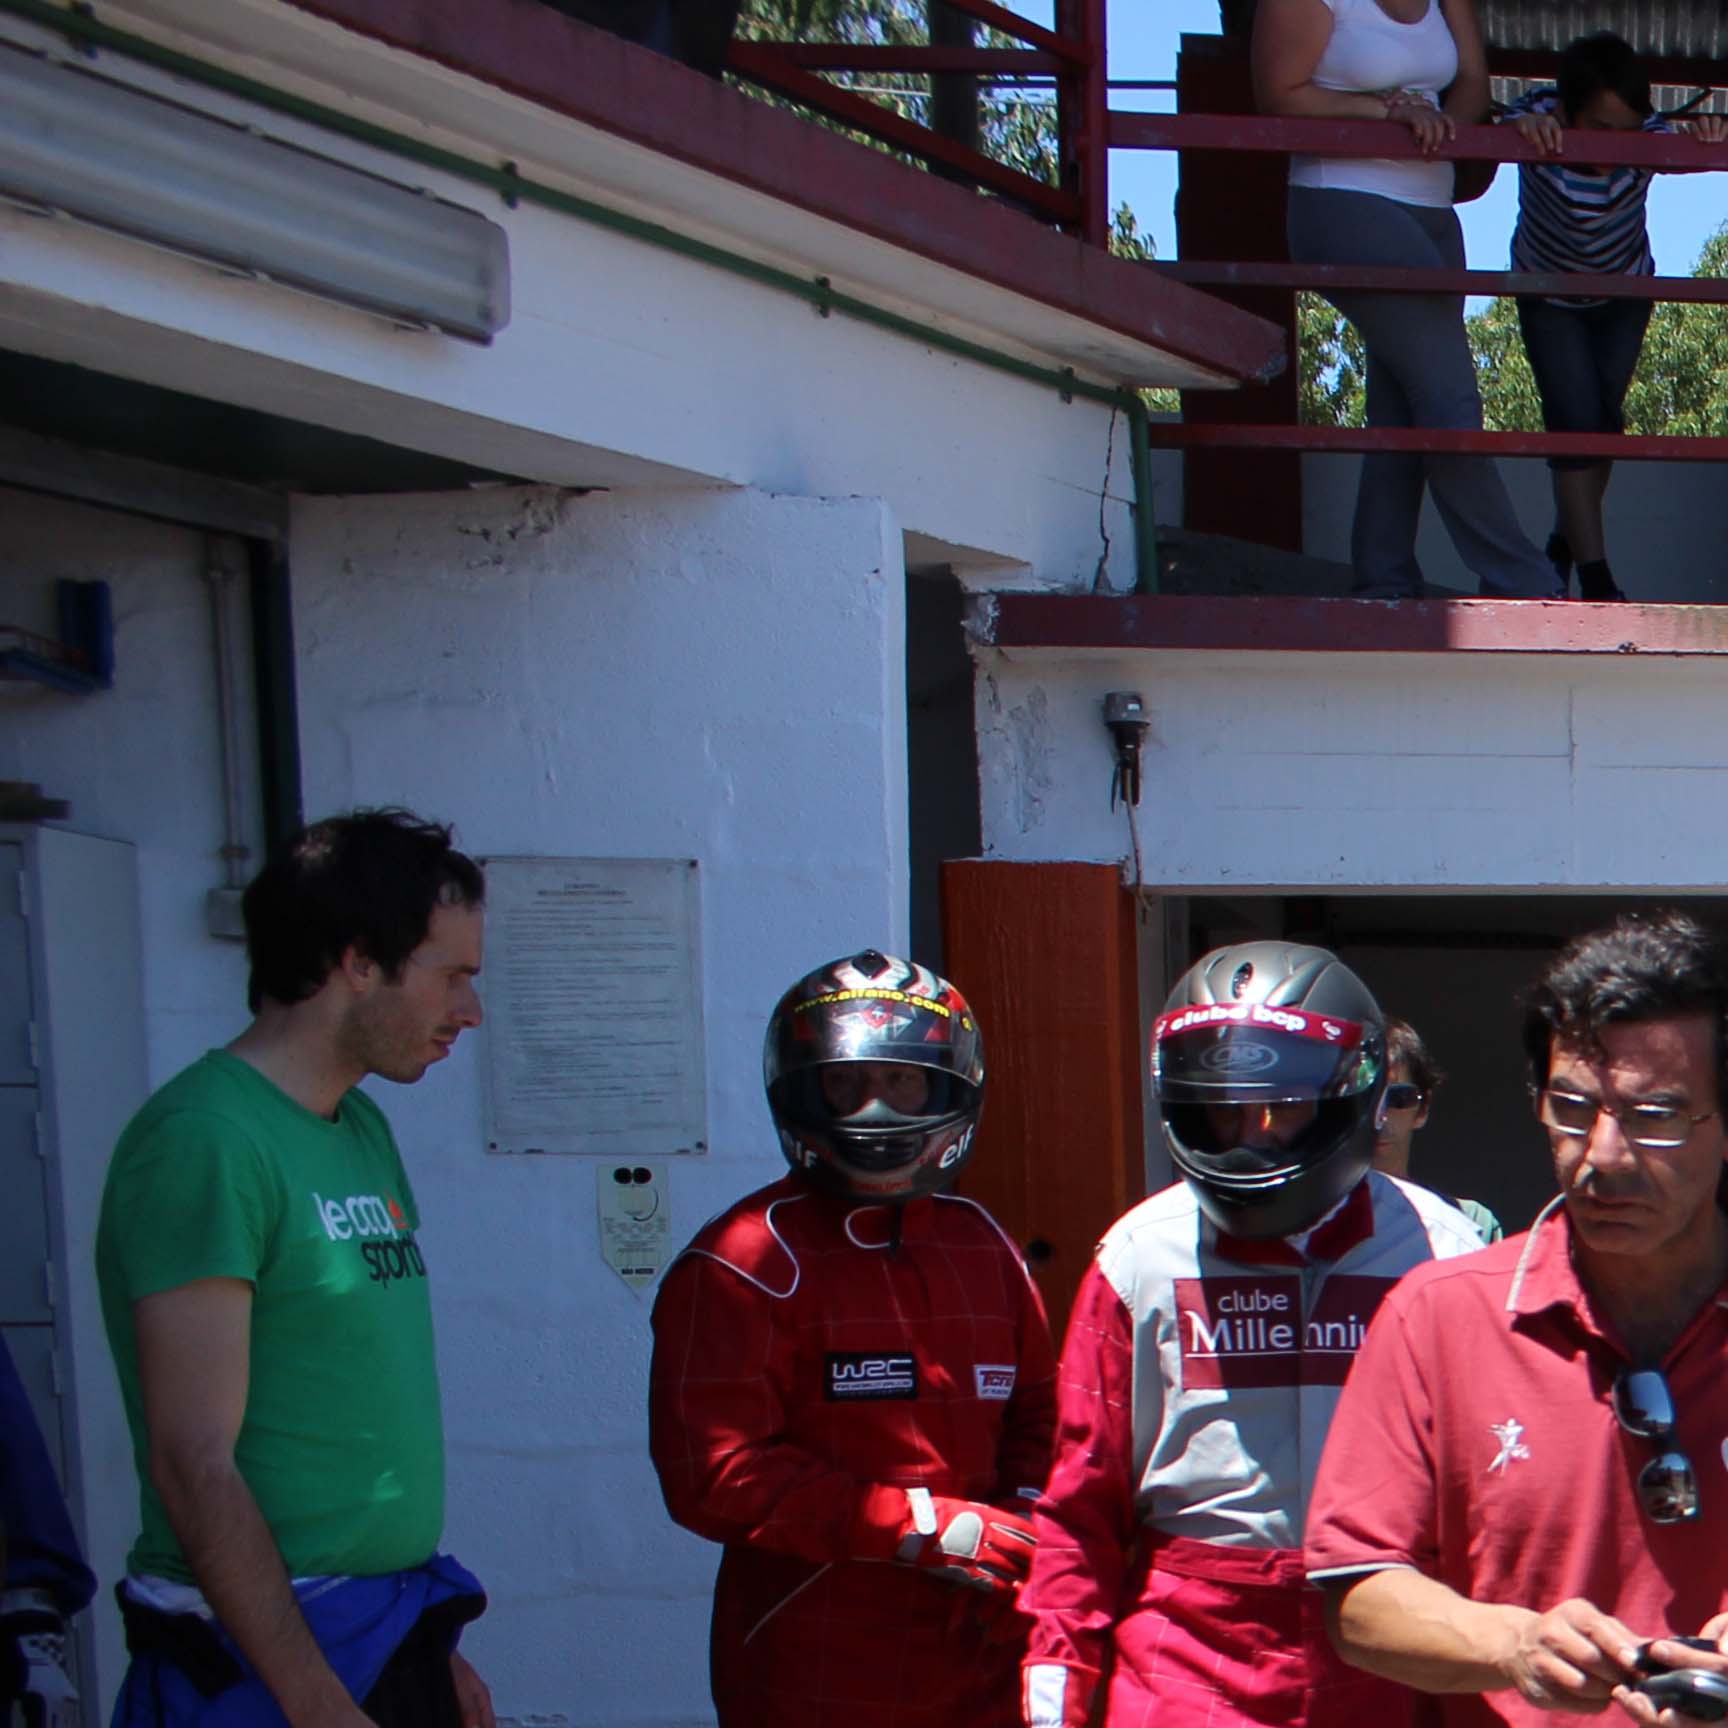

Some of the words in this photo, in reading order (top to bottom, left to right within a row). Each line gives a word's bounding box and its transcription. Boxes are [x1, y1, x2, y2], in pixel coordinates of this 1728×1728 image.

[1170, 1003, 1249, 1032] clube
[1252, 1004, 1307, 1031] bcp
[939, 1124, 974, 1169] elf
[1218, 1288, 1289, 1312] clube
[832, 1358, 913, 1380] WRC
